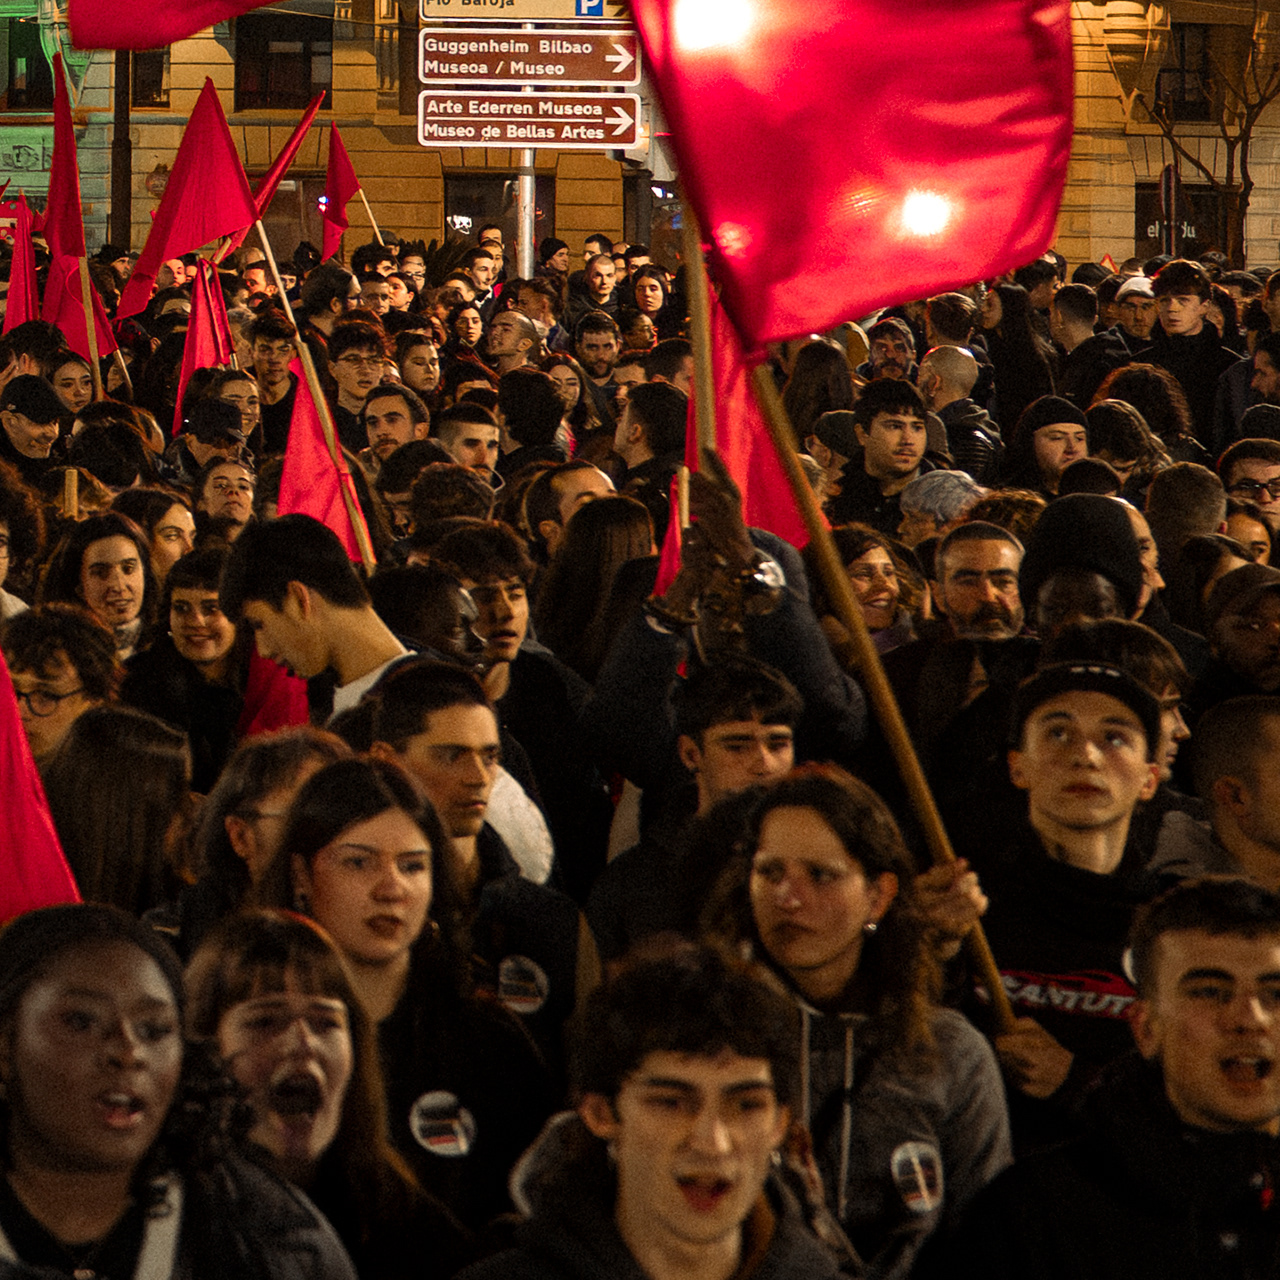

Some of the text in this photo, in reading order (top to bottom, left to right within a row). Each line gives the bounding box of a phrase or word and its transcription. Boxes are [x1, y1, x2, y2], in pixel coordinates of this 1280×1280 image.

[424, 38, 592, 57] Guggenheim Bilbao
[424, 60, 488, 74] Museoa
[510, 61, 565, 75] Museo
[427, 100, 603, 116] Arte Ederren Museoa
[424, 123, 604, 140] Museo de Bellas Artes
